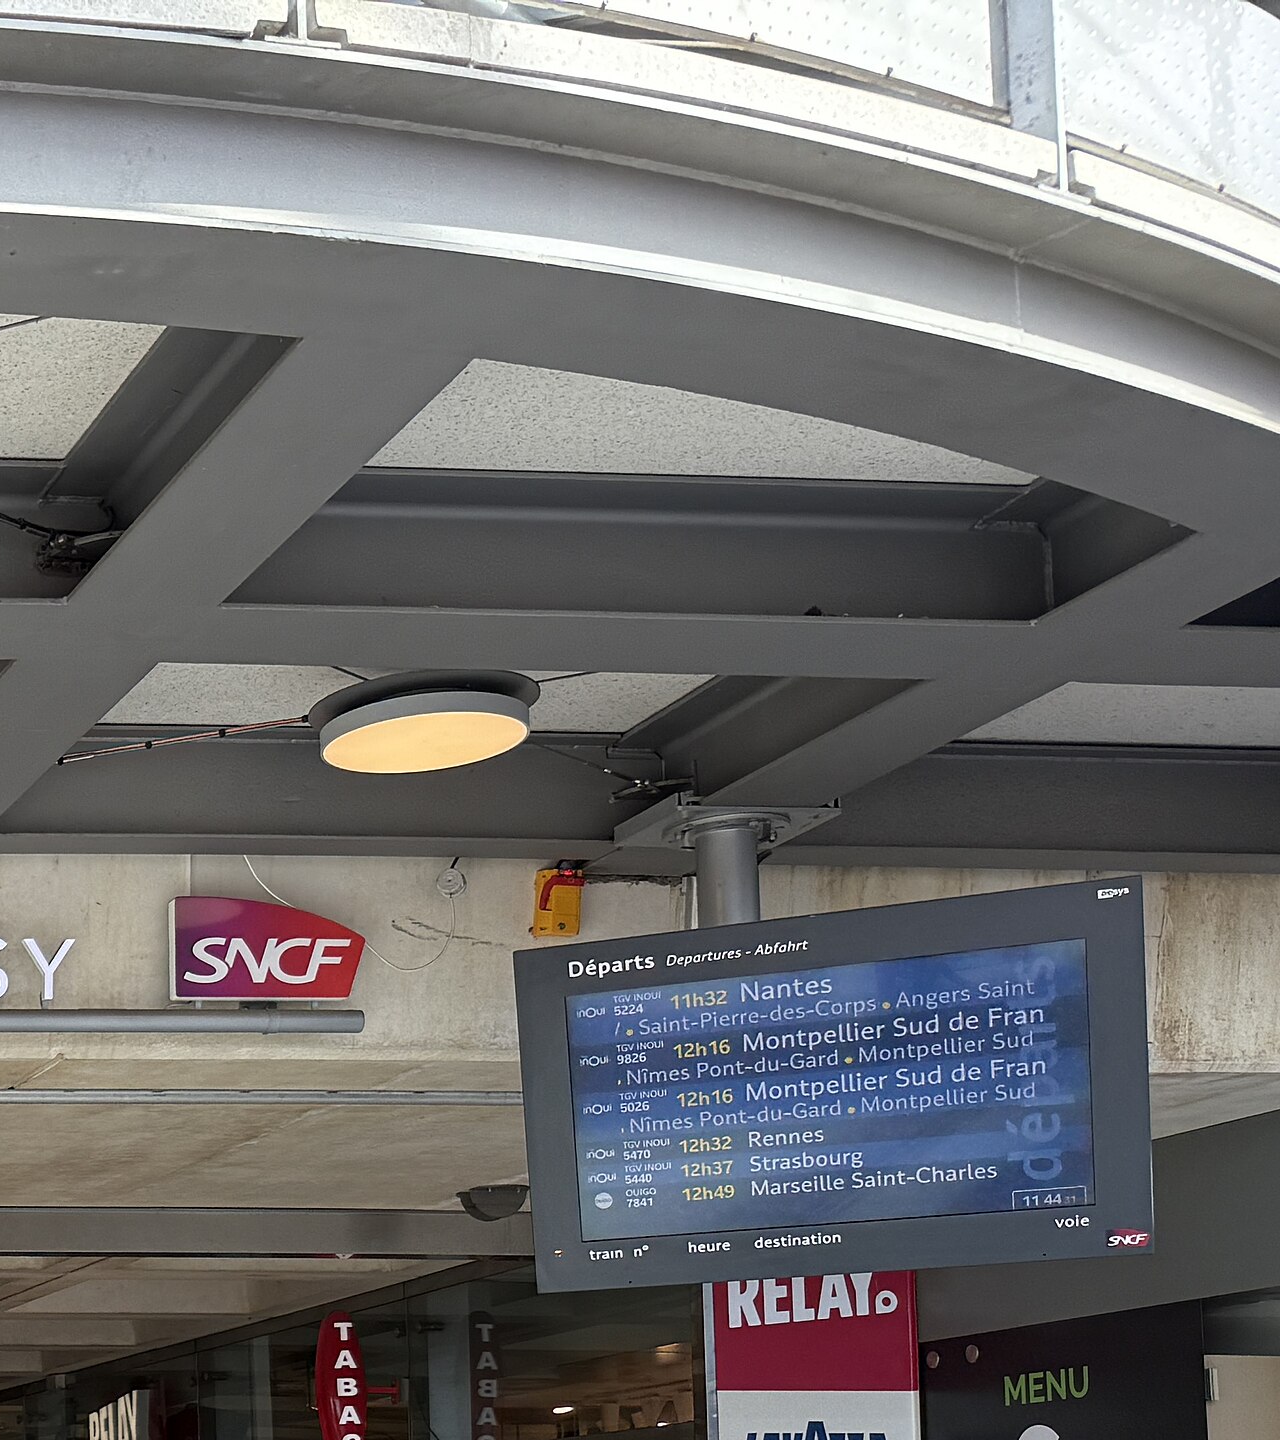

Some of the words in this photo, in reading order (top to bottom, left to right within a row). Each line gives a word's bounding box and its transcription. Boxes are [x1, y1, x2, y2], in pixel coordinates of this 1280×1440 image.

[182, 934, 351, 985] SNCF
[568, 955, 655, 978] Départs
[666, 949, 741, 967] Departures
[754, 940, 808, 956] Abfahrt
[613, 994, 631, 1004] TGV
[633, 991, 661, 1001] INOUI
[670, 990, 727, 1010] 11h32
[740, 977, 833, 1003] Nantes
[614, 1004, 643, 1016] 5224
[639, 998, 876, 1036] Saint-Pierre-des-Corps
[896, 987, 970, 1009] Angers
[979, 979, 1035, 1000] Saint
[743, 1022, 885, 1053] Montpellier
[893, 1015, 939, 1037] Sud
[949, 1011, 979, 1032] de
[989, 1007, 1044, 1027] Fran
[617, 1044, 635, 1053] TGV
[636, 1040, 664, 1051] INOUI
[673, 1039, 730, 1060] 12h16
[617, 1053, 646, 1065] 9826
[626, 1065, 690, 1085] Nîmes
[697, 1050, 839, 1079] Pont-du-Gard
[859, 1036, 985, 1065] Montpellier
[992, 1031, 1034, 1050] Sud
[746, 1071, 888, 1102] Montpellier
[896, 1066, 941, 1088] Sud
[951, 1063, 981, 1083] de
[990, 1058, 1046, 1079] Fran
[620, 1092, 638, 1100] TGV
[639, 1089, 667, 1099] INOUI
[676, 1088, 734, 1109] 12h16
[620, 1101, 649, 1113] 5026
[629, 1113, 693, 1133] Nîmes
[700, 1100, 841, 1128] Pont-du-Gard
[861, 1088, 987, 1115] Montpellier
[995, 1082, 1036, 1101] Sud
[623, 1141, 641, 1150] TGV
[642, 1138, 670, 1148] INOUI
[679, 1136, 732, 1154] 12h32
[748, 1128, 824, 1148] Rennes
[623, 1150, 651, 1161] 5470
[749, 1150, 863, 1172] Strasbourg
[624, 1165, 642, 1174] TGV
[644, 1162, 671, 1171] INOUI
[680, 1161, 733, 1178] 12h37
[625, 1174, 652, 1184] 5440
[750, 1173, 844, 1197] Marseille
[851, 1164, 998, 1189] Saint-Charles
[625, 1187, 656, 1197] OUIGO
[682, 1185, 735, 1202] 12h49
[626, 1197, 653, 1208] 7841
[589, 1248, 623, 1261] train
[633, 1245, 649, 1257] n°
[687, 1240, 731, 1254] heure
[754, 1232, 842, 1249] destination
[1054, 1215, 1090, 1228] voie
[1107, 1233, 1148, 1247] SNCF
[727, 1272, 873, 1328] RELAY
[1004, 1365, 1089, 1407] MENU
